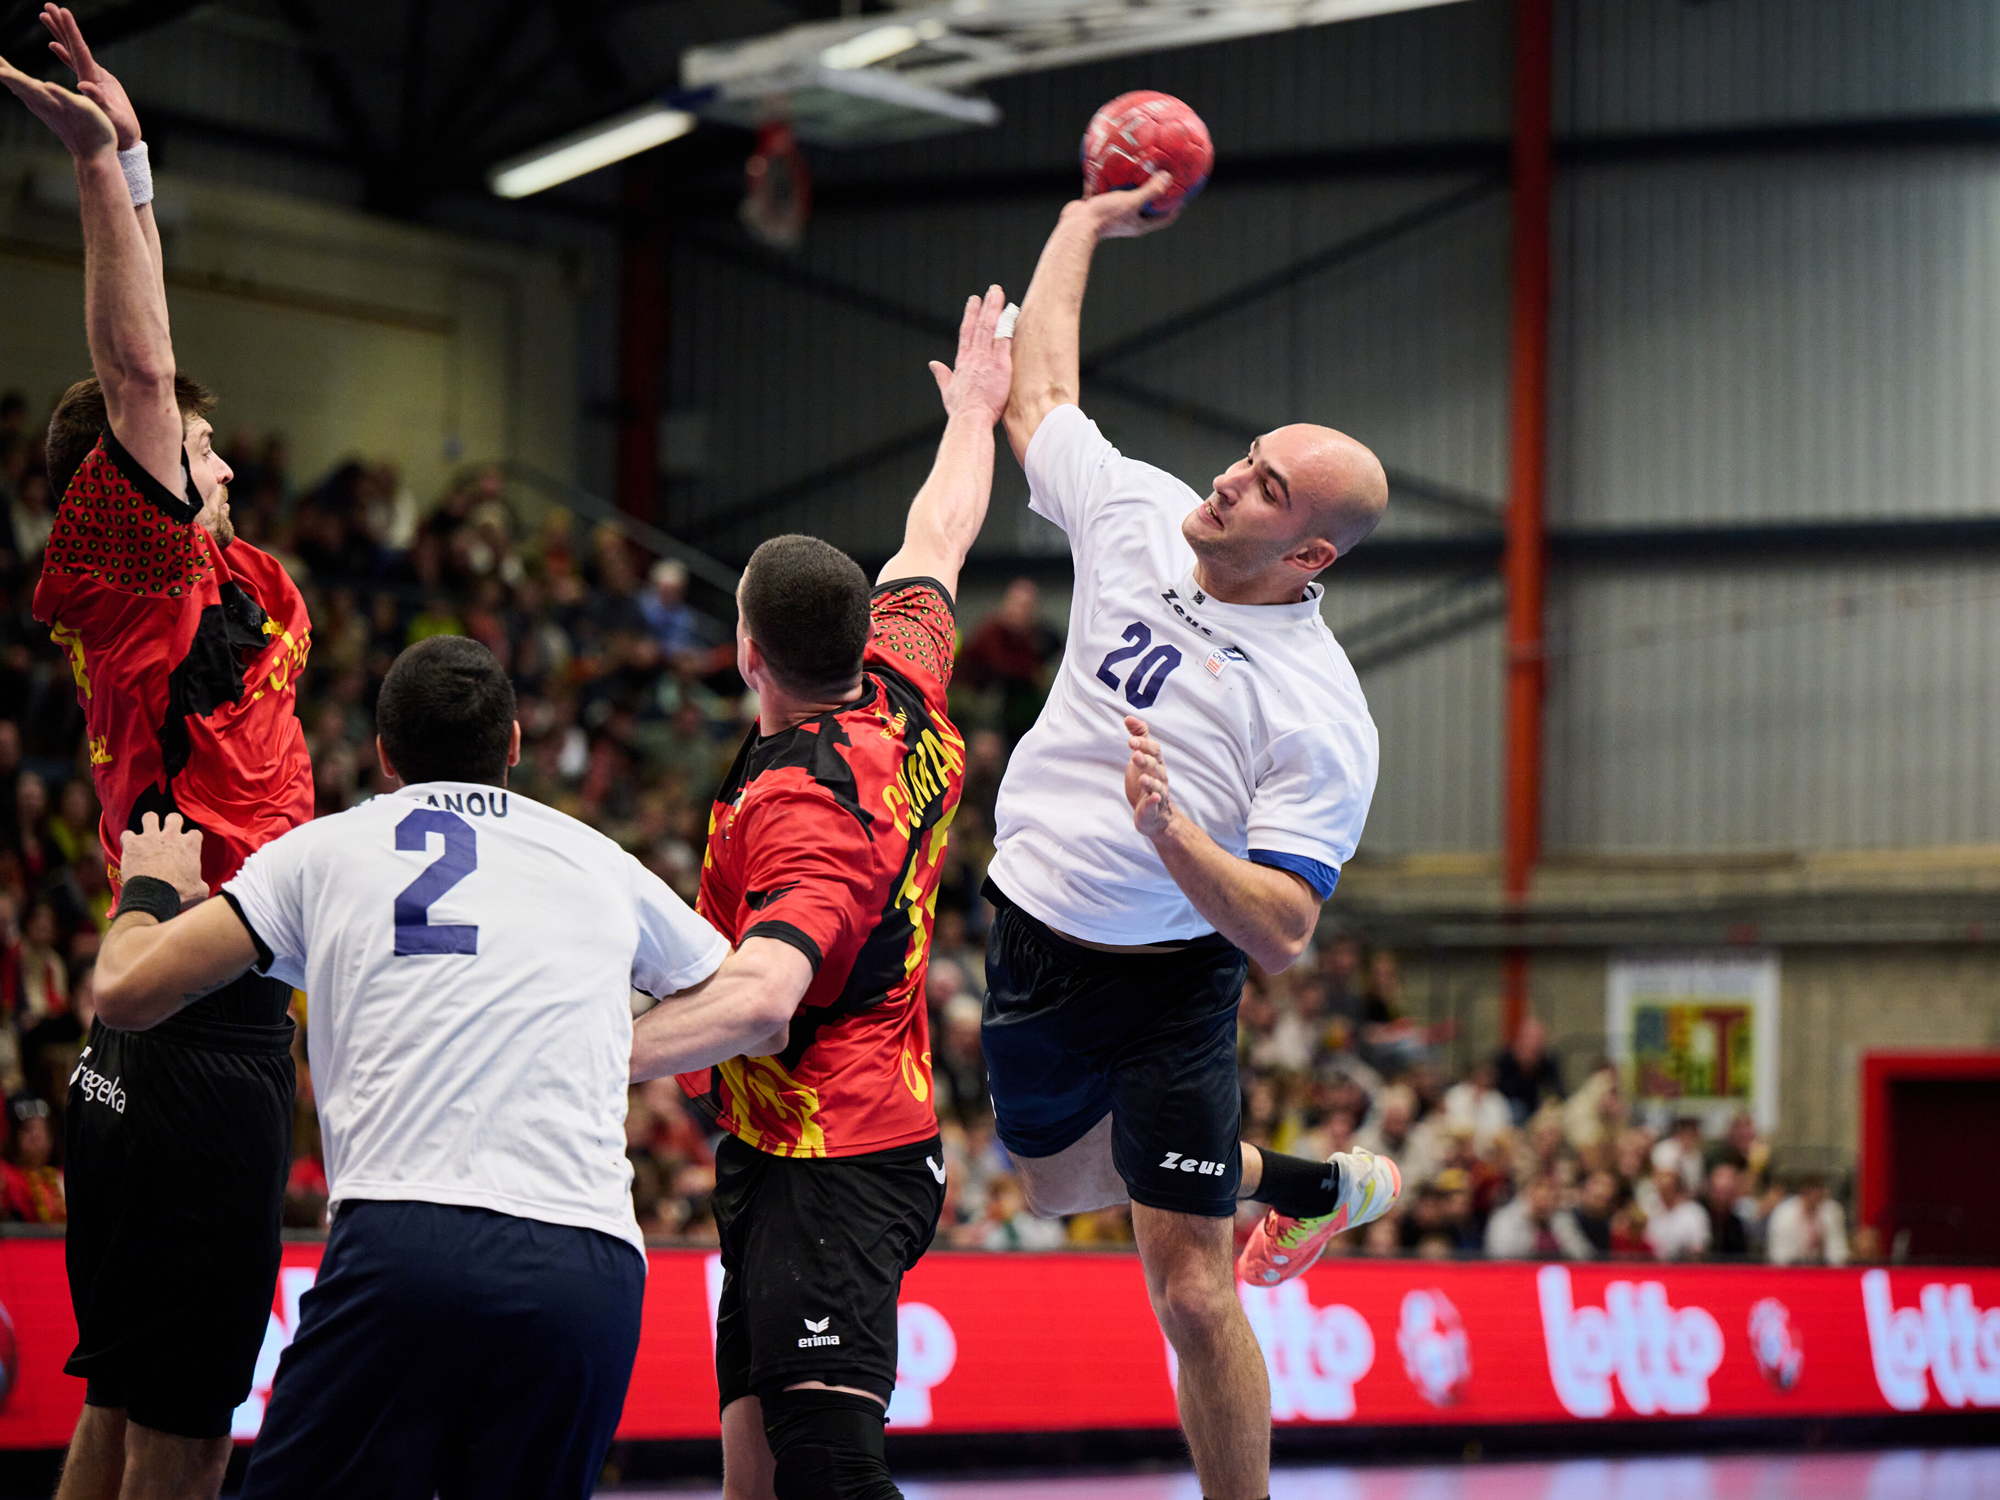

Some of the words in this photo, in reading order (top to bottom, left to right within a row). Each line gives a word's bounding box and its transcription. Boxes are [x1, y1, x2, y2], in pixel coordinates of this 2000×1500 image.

[1096, 621, 1183, 710] 20
[394, 808, 479, 957] 2
[1159, 1151, 1226, 1177] Zeus
[798, 1334, 840, 1348] erima
[1537, 1264, 1725, 1418] lotto
